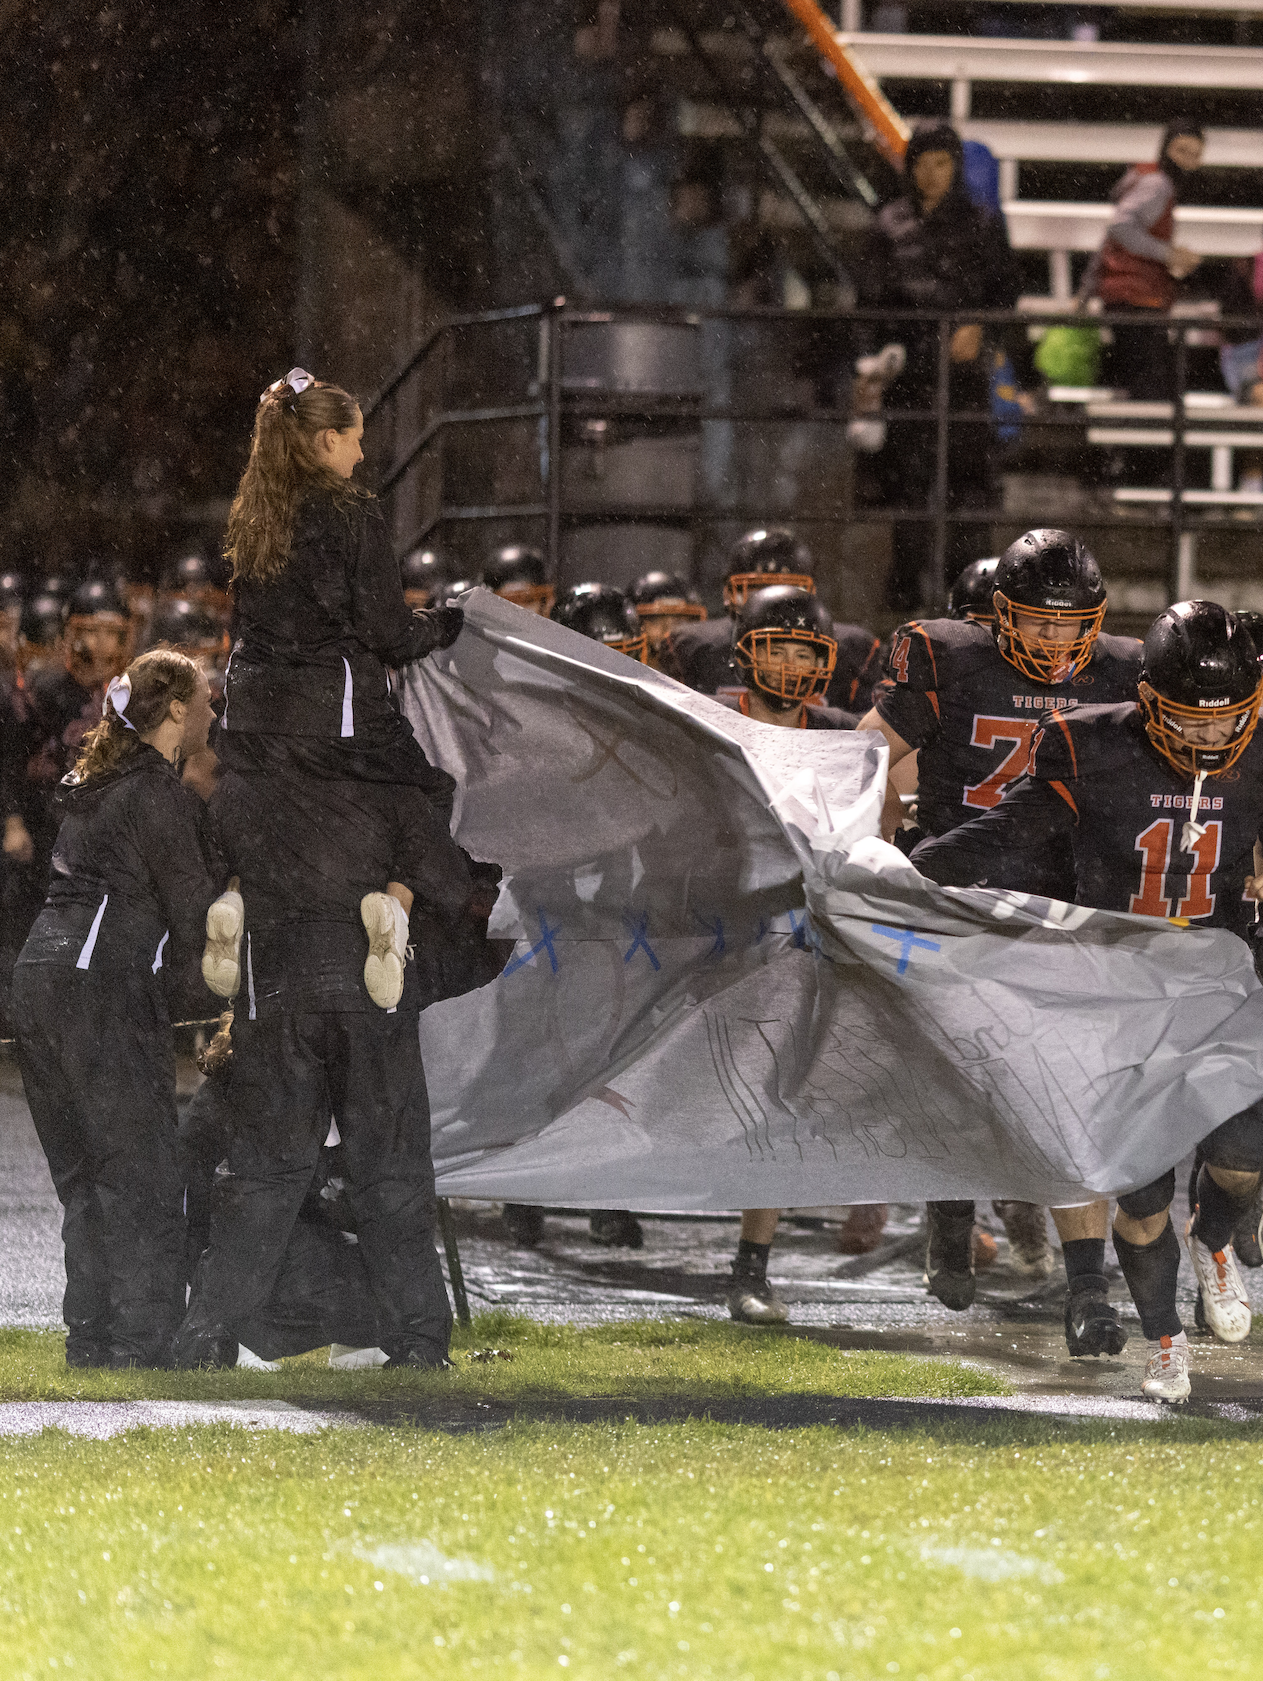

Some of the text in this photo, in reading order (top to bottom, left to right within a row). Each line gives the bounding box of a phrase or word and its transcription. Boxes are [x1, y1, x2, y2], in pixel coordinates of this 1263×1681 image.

[1198, 698, 1230, 708] Riddell
[1150, 794, 1224, 810] TIGERS
[1129, 818, 1223, 920] 11
